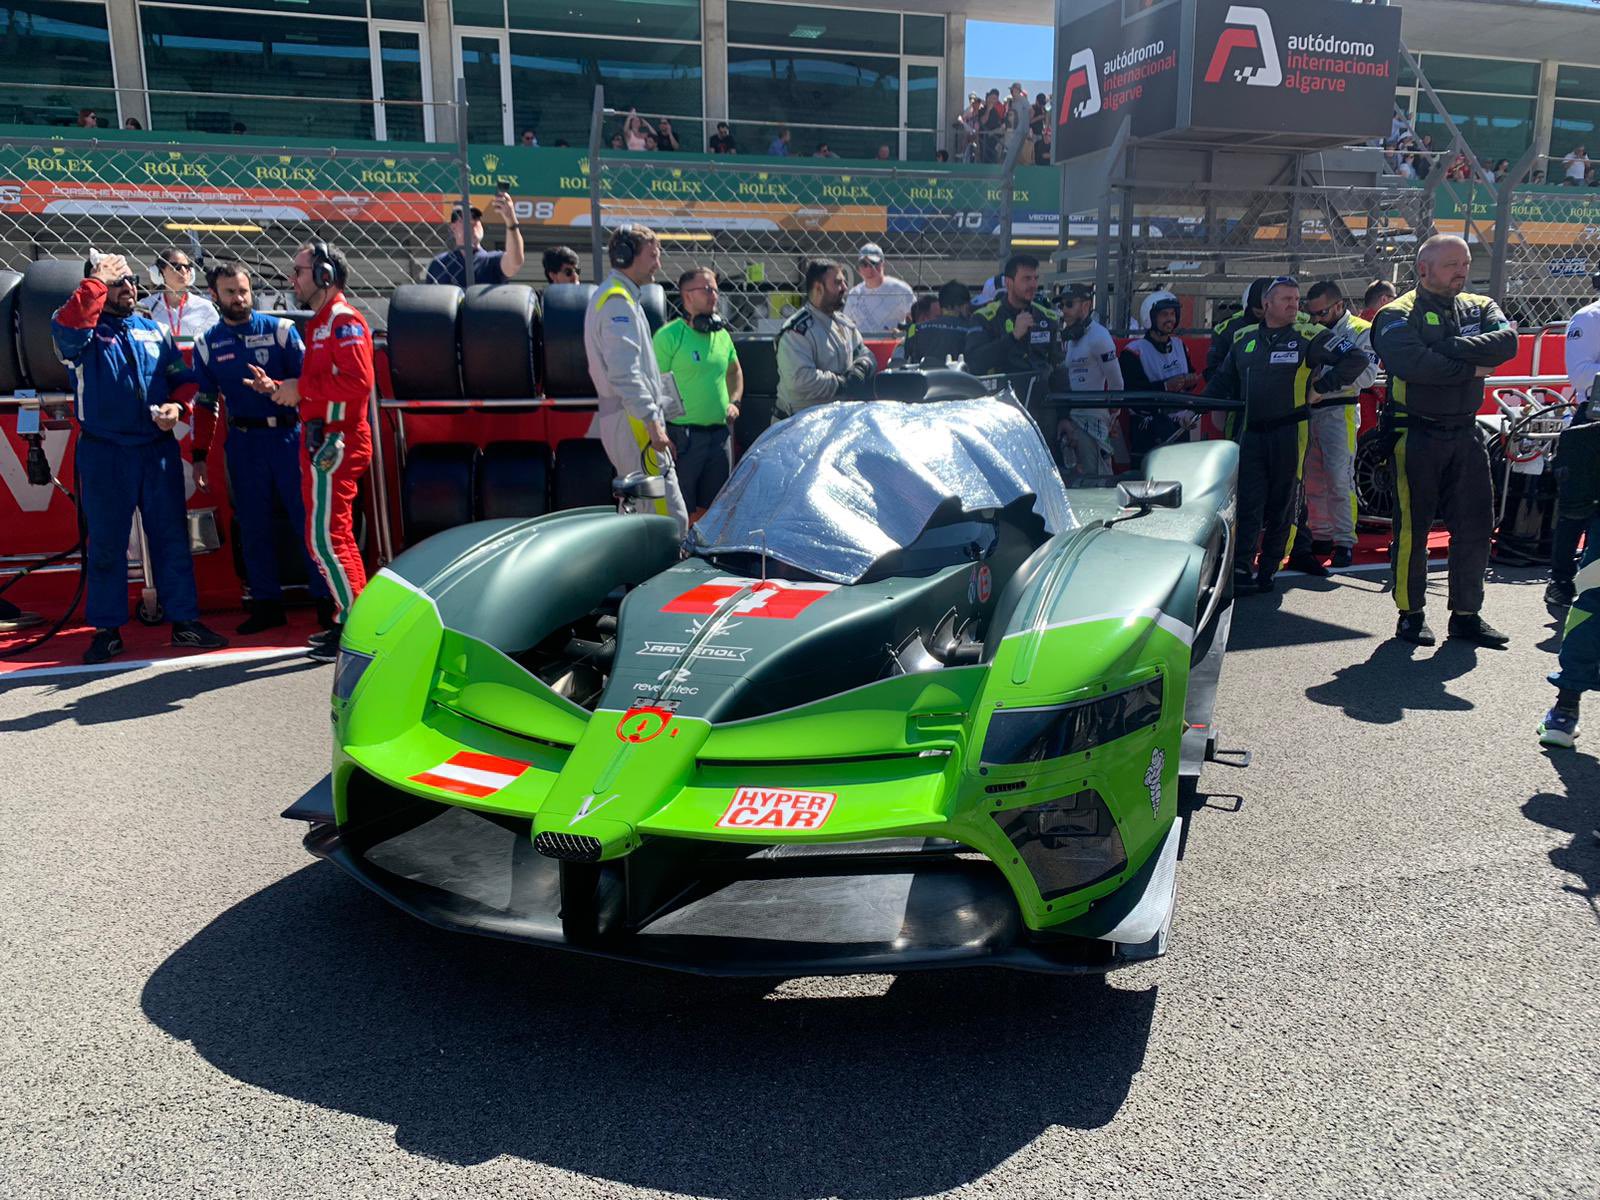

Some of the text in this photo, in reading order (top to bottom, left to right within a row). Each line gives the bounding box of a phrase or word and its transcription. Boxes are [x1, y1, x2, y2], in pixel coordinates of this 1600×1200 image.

[1288, 32, 1375, 57] autódromo
[1104, 39, 1164, 75] autódromo
[1287, 50, 1389, 78] internacional
[1103, 50, 1176, 92] internacional
[1285, 73, 1346, 94] algarve
[1103, 85, 1143, 111] algarve
[27, 157, 93, 173] ROLEX
[145, 162, 208, 177] ROLEX
[256, 166, 318, 181] ROLEX
[361, 170, 419, 184] ROLEX
[560, 176, 612, 190] ROLX
[651, 179, 701, 193] ROLEX
[739, 182, 787, 196] ROLEX
[822, 185, 870, 198] ROLEX
[910, 188, 954, 200] ROLEX
[987, 190, 1029, 202] ROEX
[955, 212, 983, 228] 10
[738, 791, 827, 811] HYPER
[728, 806, 819, 827] CAR
